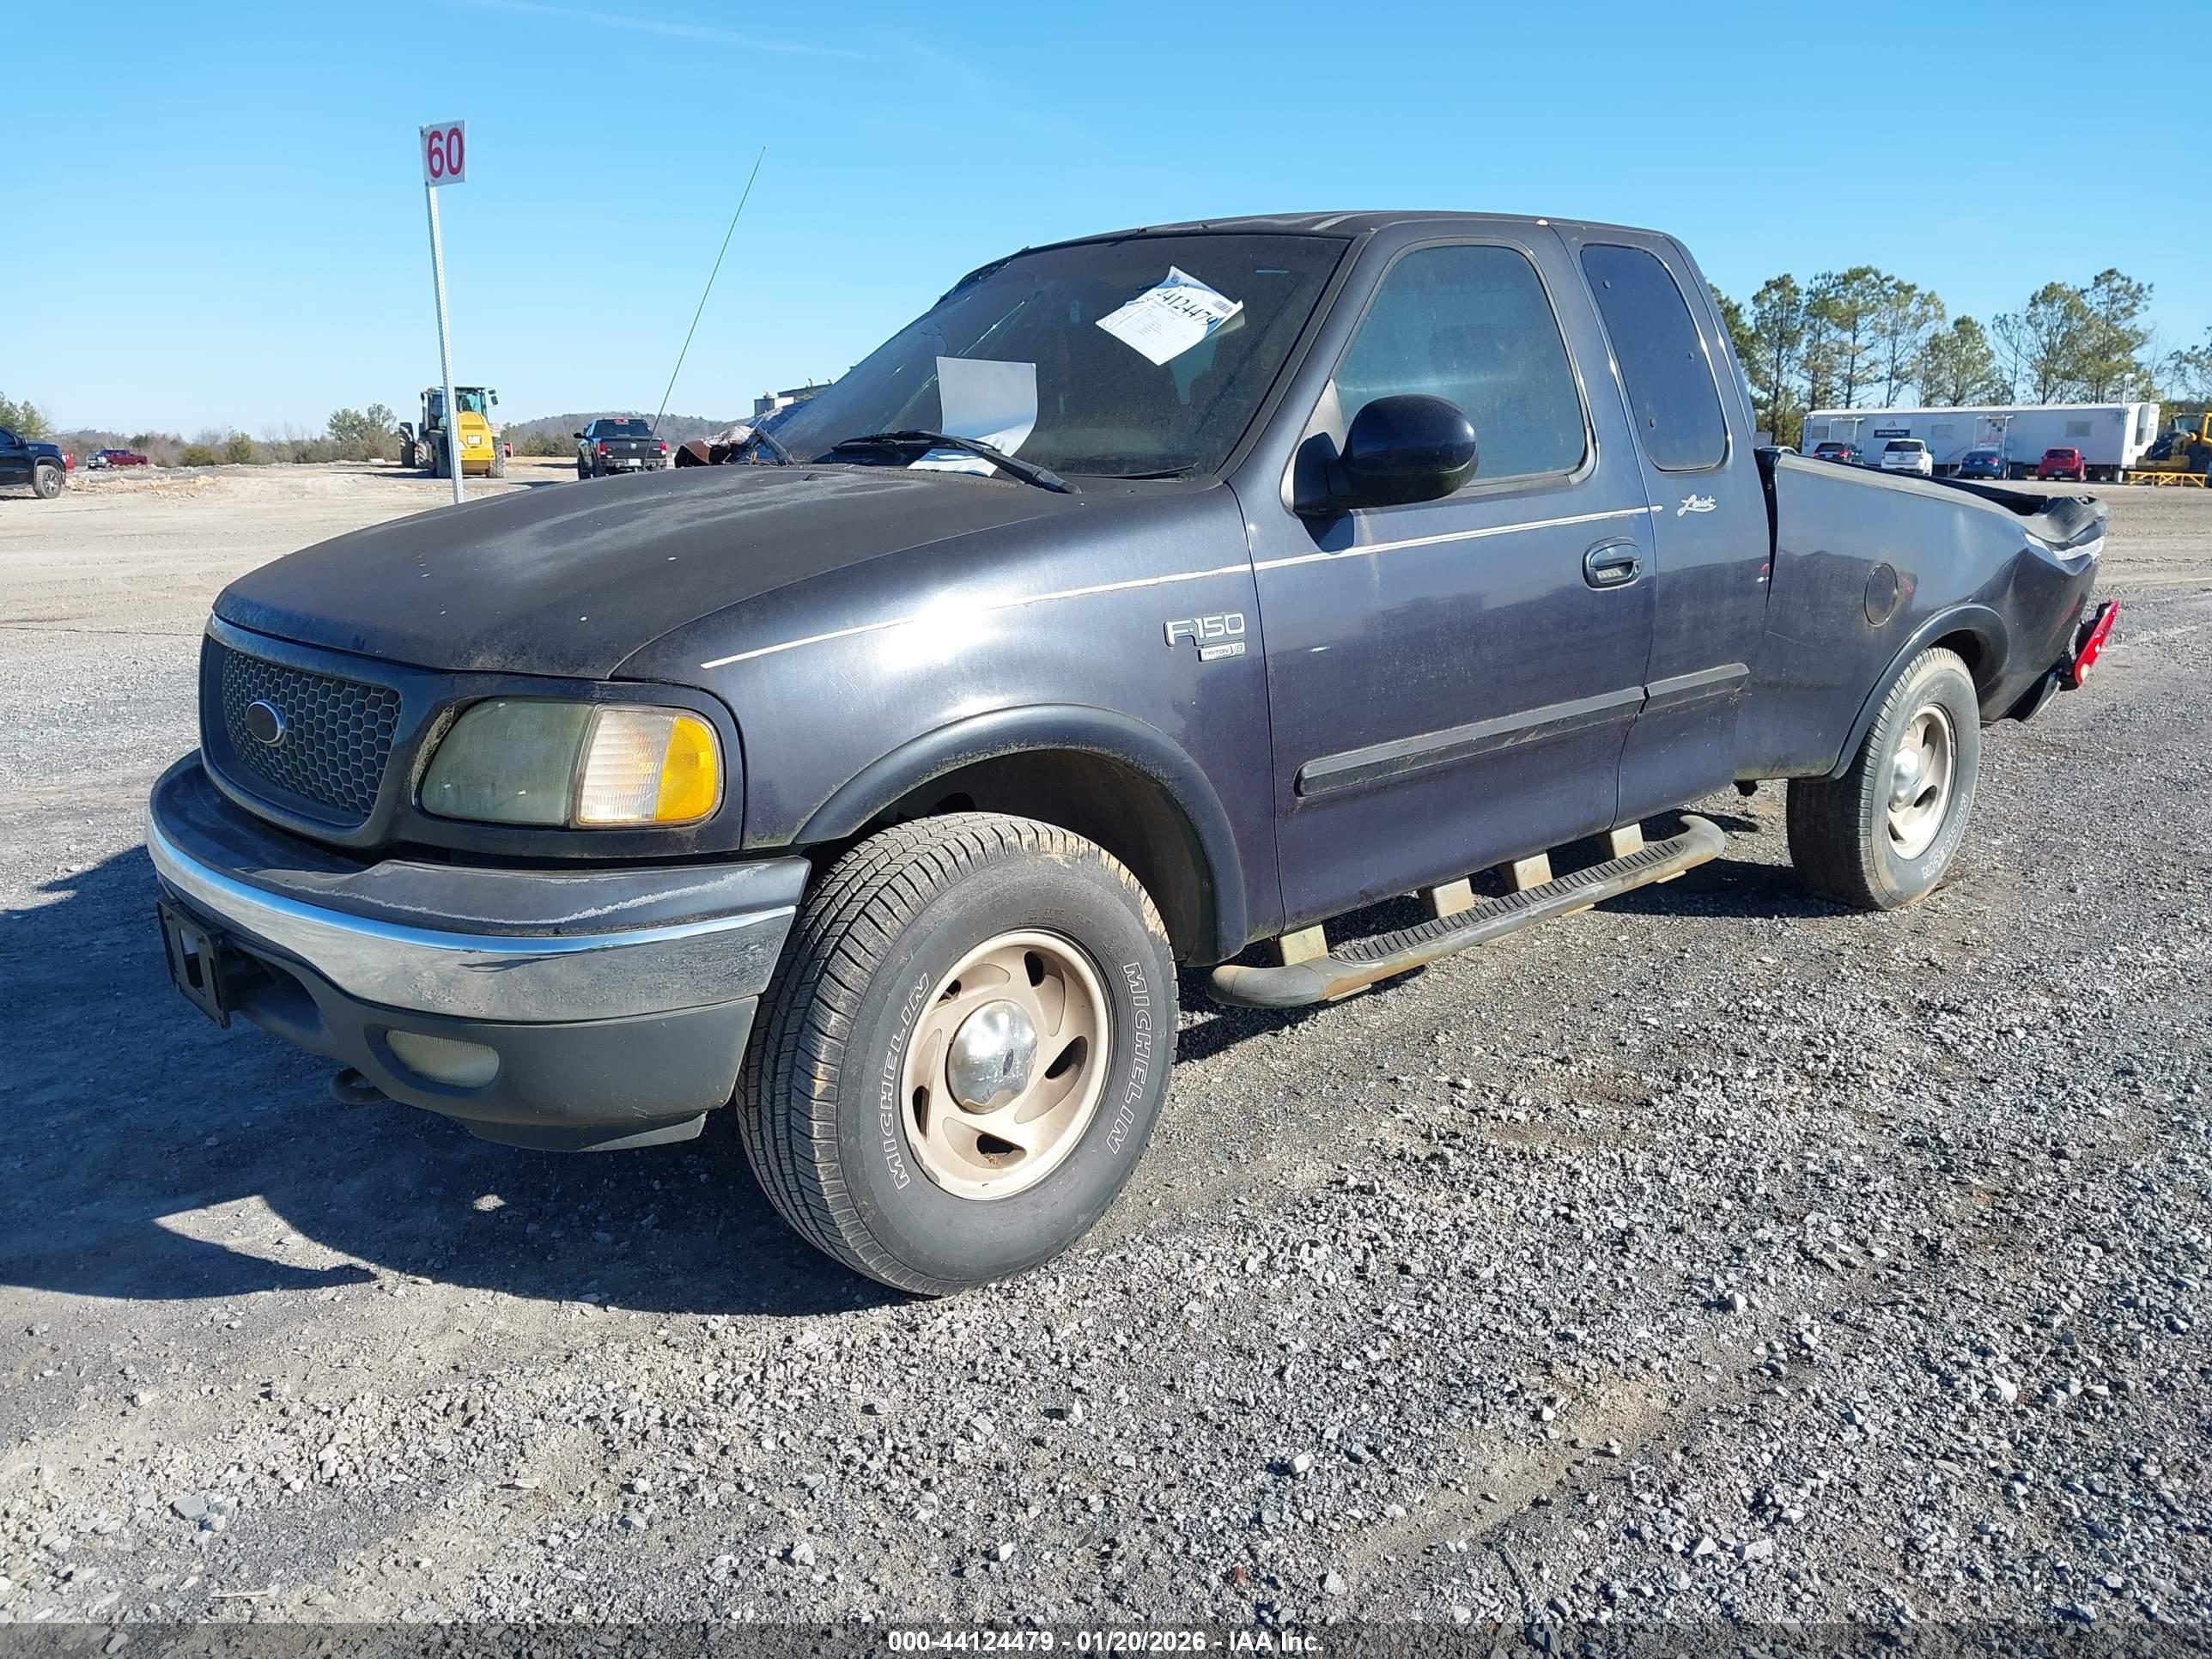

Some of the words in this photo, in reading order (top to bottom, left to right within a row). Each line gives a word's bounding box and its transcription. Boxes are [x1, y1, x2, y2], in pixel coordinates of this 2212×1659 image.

[428, 127, 464, 179] 60
[1204, 647, 1229, 658] TRITON
[1230, 644, 1243, 656] V8
[880, 972, 930, 1190] MICHELIN
[1106, 961, 1152, 1155] MICHELIN
